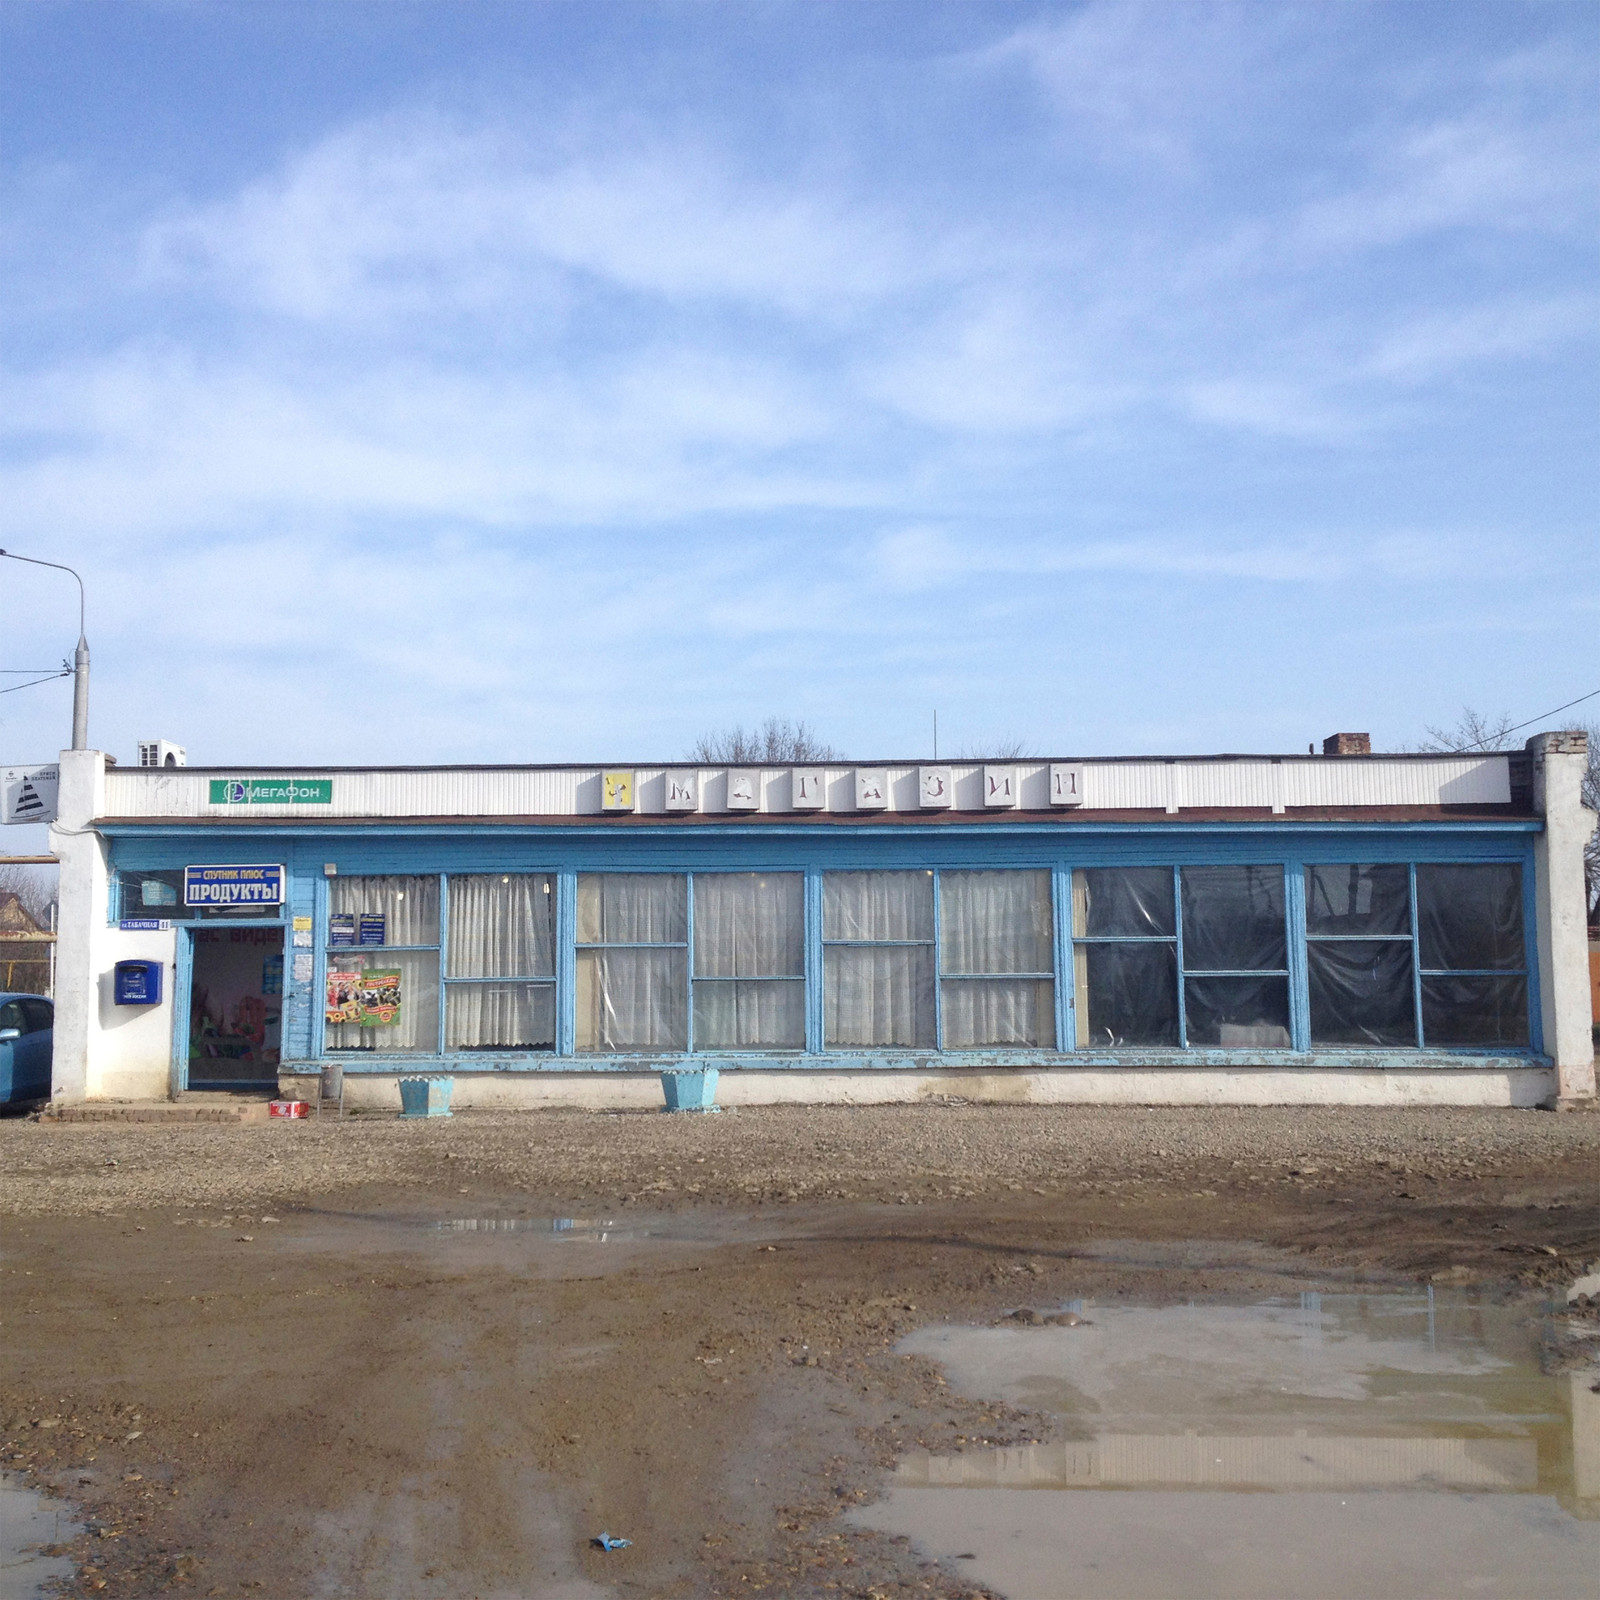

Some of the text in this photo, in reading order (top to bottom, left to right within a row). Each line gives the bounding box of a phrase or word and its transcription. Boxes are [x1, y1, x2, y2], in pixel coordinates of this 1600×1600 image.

[203, 869, 265, 880] СПУТНИК ПЛЮС
[189, 883, 279, 903] ПРОДУКТЫ
